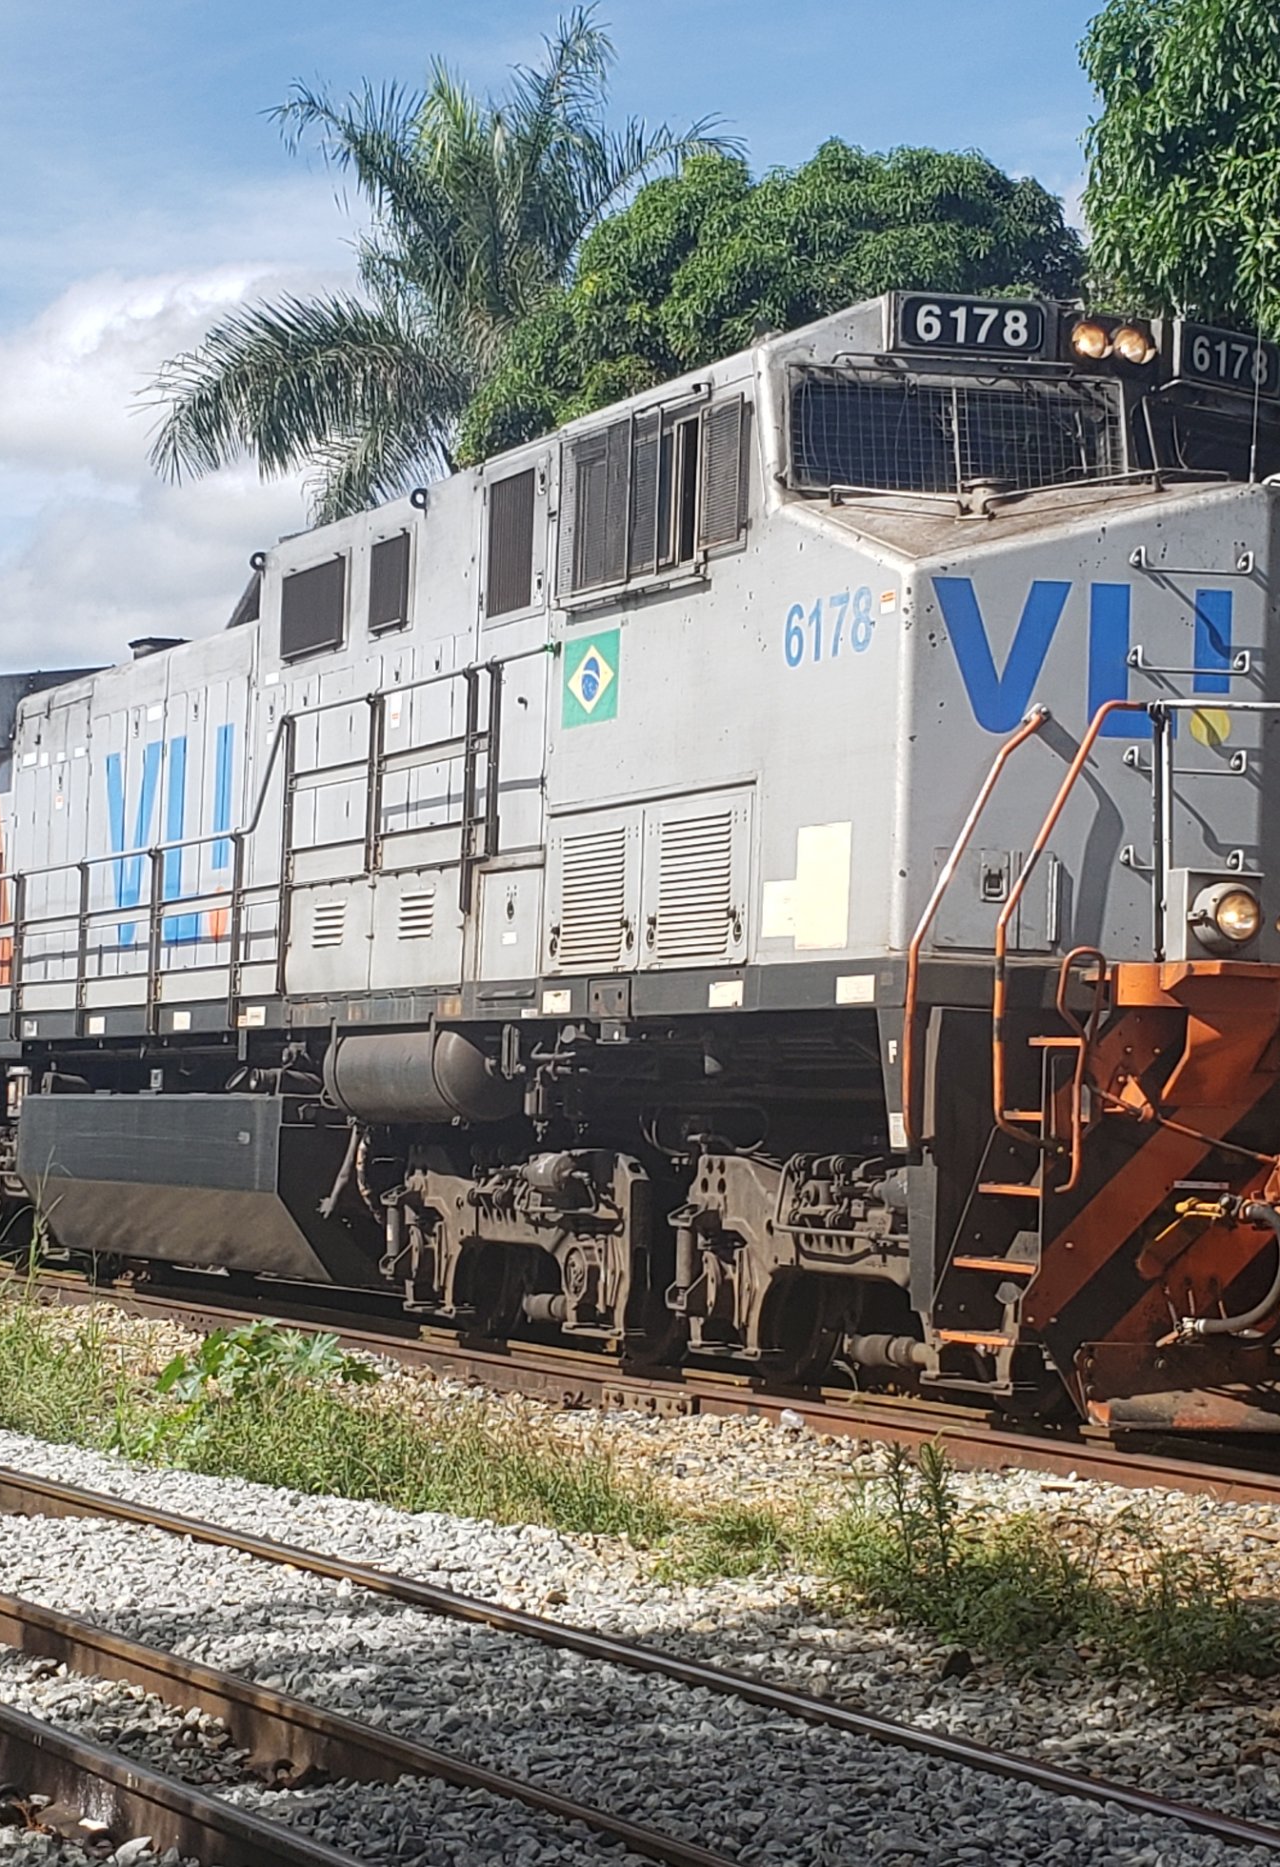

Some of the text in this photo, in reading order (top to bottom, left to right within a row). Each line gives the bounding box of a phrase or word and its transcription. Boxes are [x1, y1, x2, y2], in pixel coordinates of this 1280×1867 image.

[916, 304, 1028, 347] 6178
[1192, 335, 1268, 386] 6178
[784, 586, 873, 668] 6178
